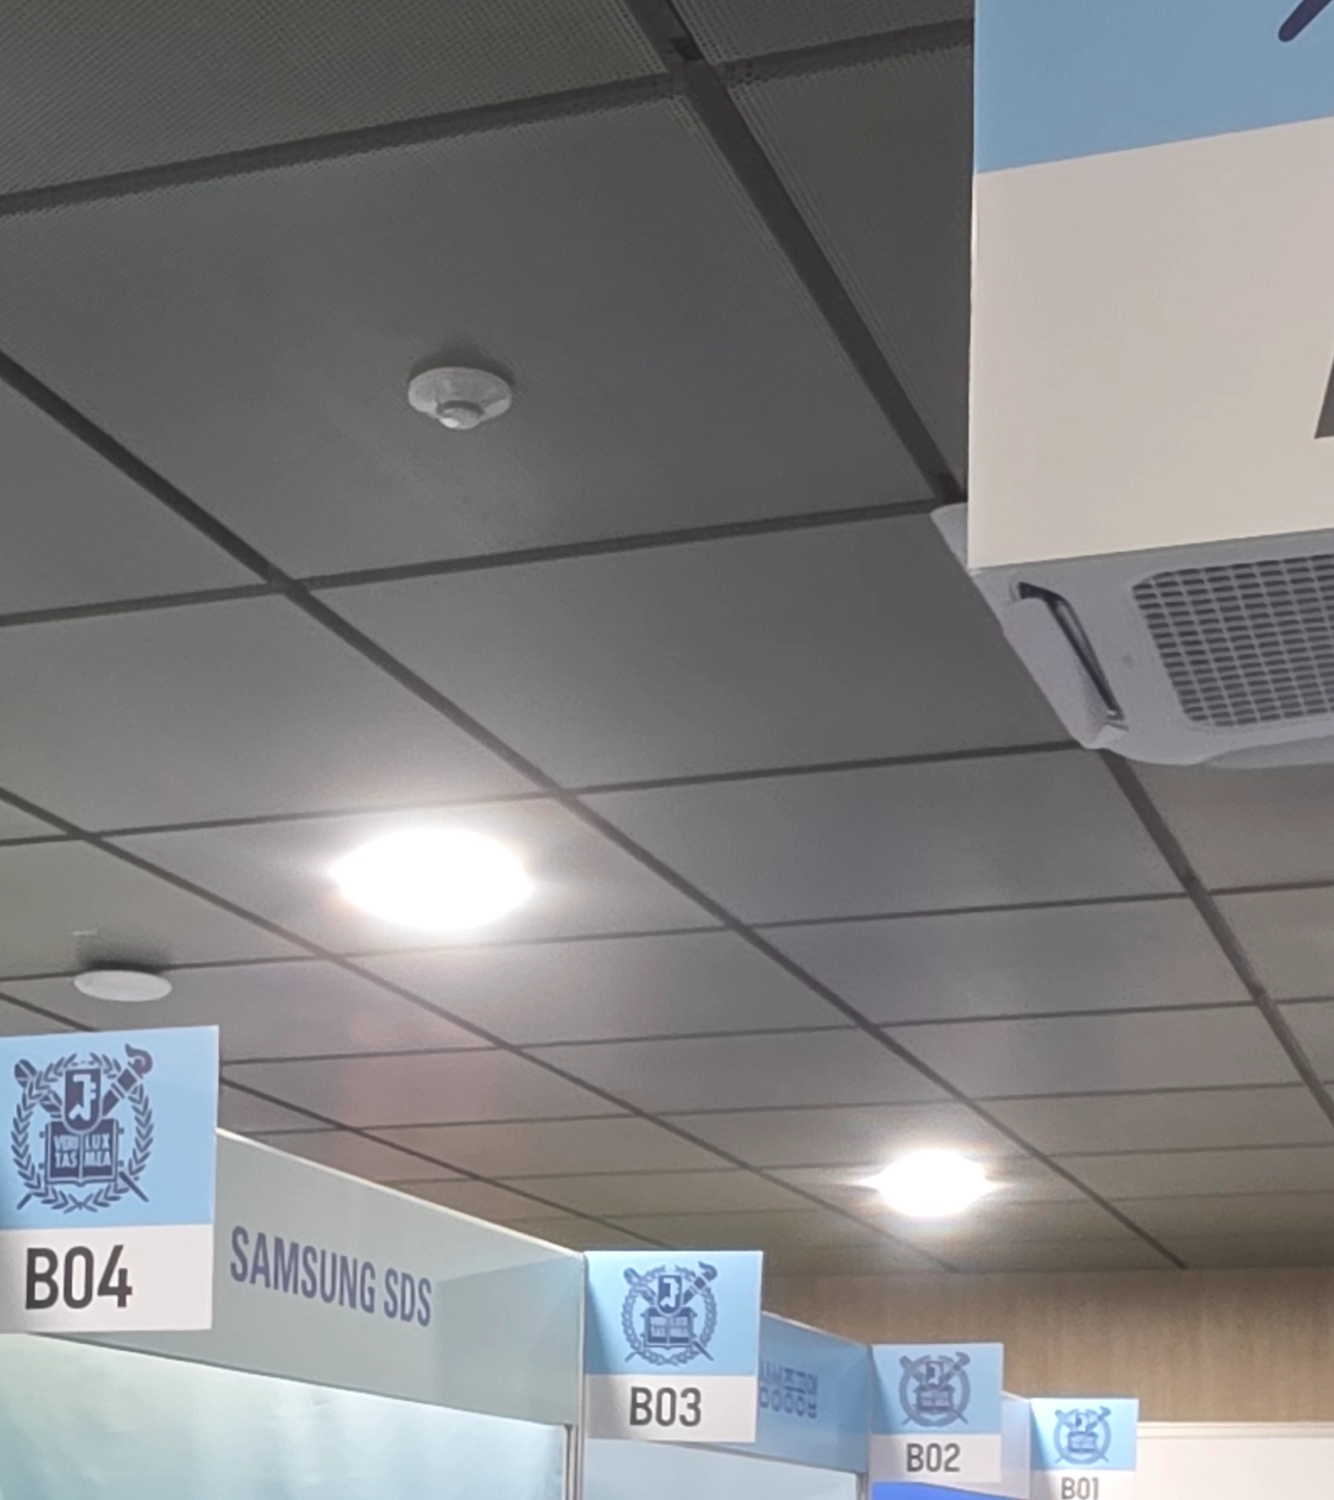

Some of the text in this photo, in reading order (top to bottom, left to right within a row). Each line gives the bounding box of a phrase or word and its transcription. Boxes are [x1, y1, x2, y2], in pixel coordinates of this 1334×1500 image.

[25, 1244, 133, 1309] B04
[230, 1226, 431, 1327] SAMSUNG SDS
[629, 1387, 702, 1427] B03
[906, 1443, 961, 1473] B02
[1061, 1478, 1099, 1500] B01
